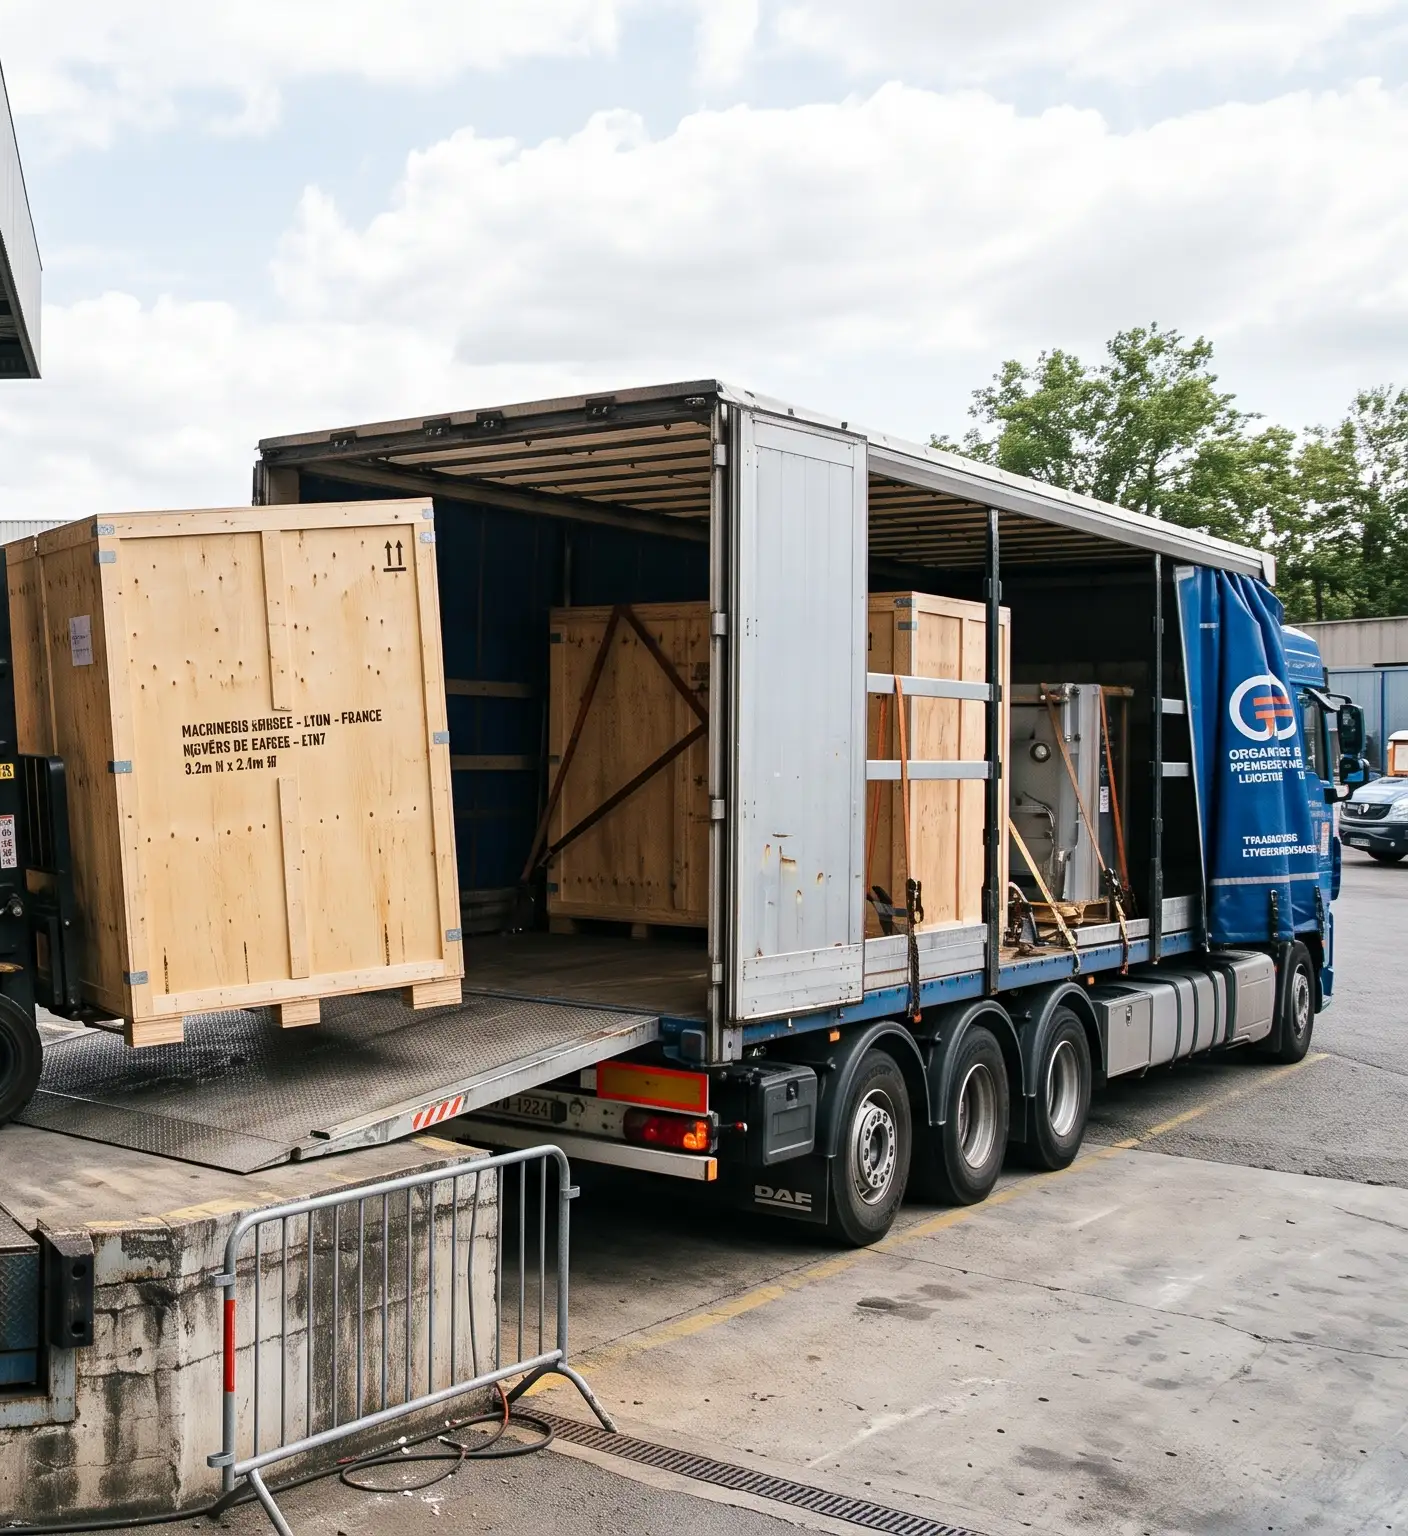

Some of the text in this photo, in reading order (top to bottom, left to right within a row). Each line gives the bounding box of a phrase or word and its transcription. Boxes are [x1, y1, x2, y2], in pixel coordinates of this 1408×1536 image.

[341, 709, 383, 725] FRANCE
[233, 738, 249, 753] DE
[185, 761, 212, 775] 3.2m
[754, 1184, 812, 1204] DAF
